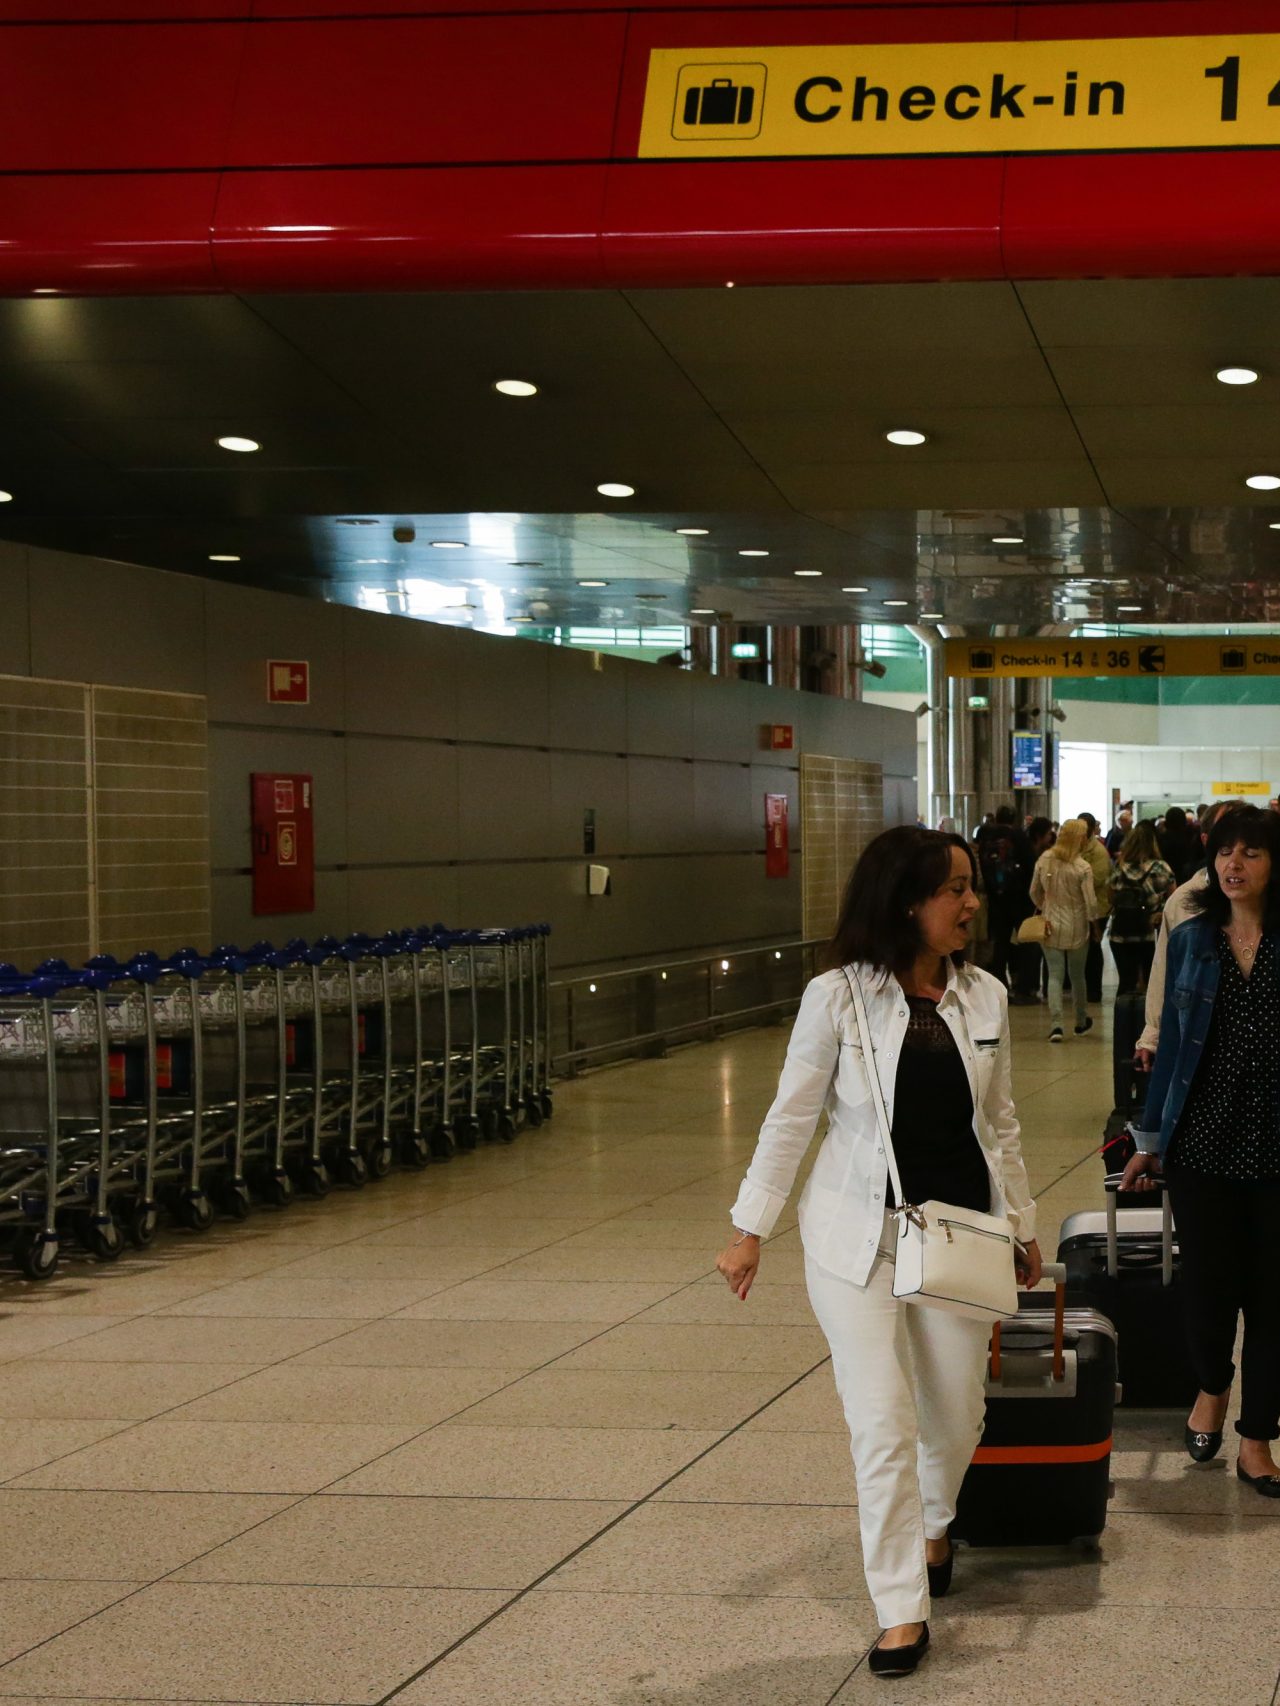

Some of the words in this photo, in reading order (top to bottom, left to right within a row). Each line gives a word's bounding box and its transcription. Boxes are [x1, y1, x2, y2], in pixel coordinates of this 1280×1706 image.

[794, 72, 1127, 123] Check-in
[1001, 654, 1057, 666] Check-in
[1061, 651, 1084, 668] 14
[1107, 651, 1130, 668] 36
